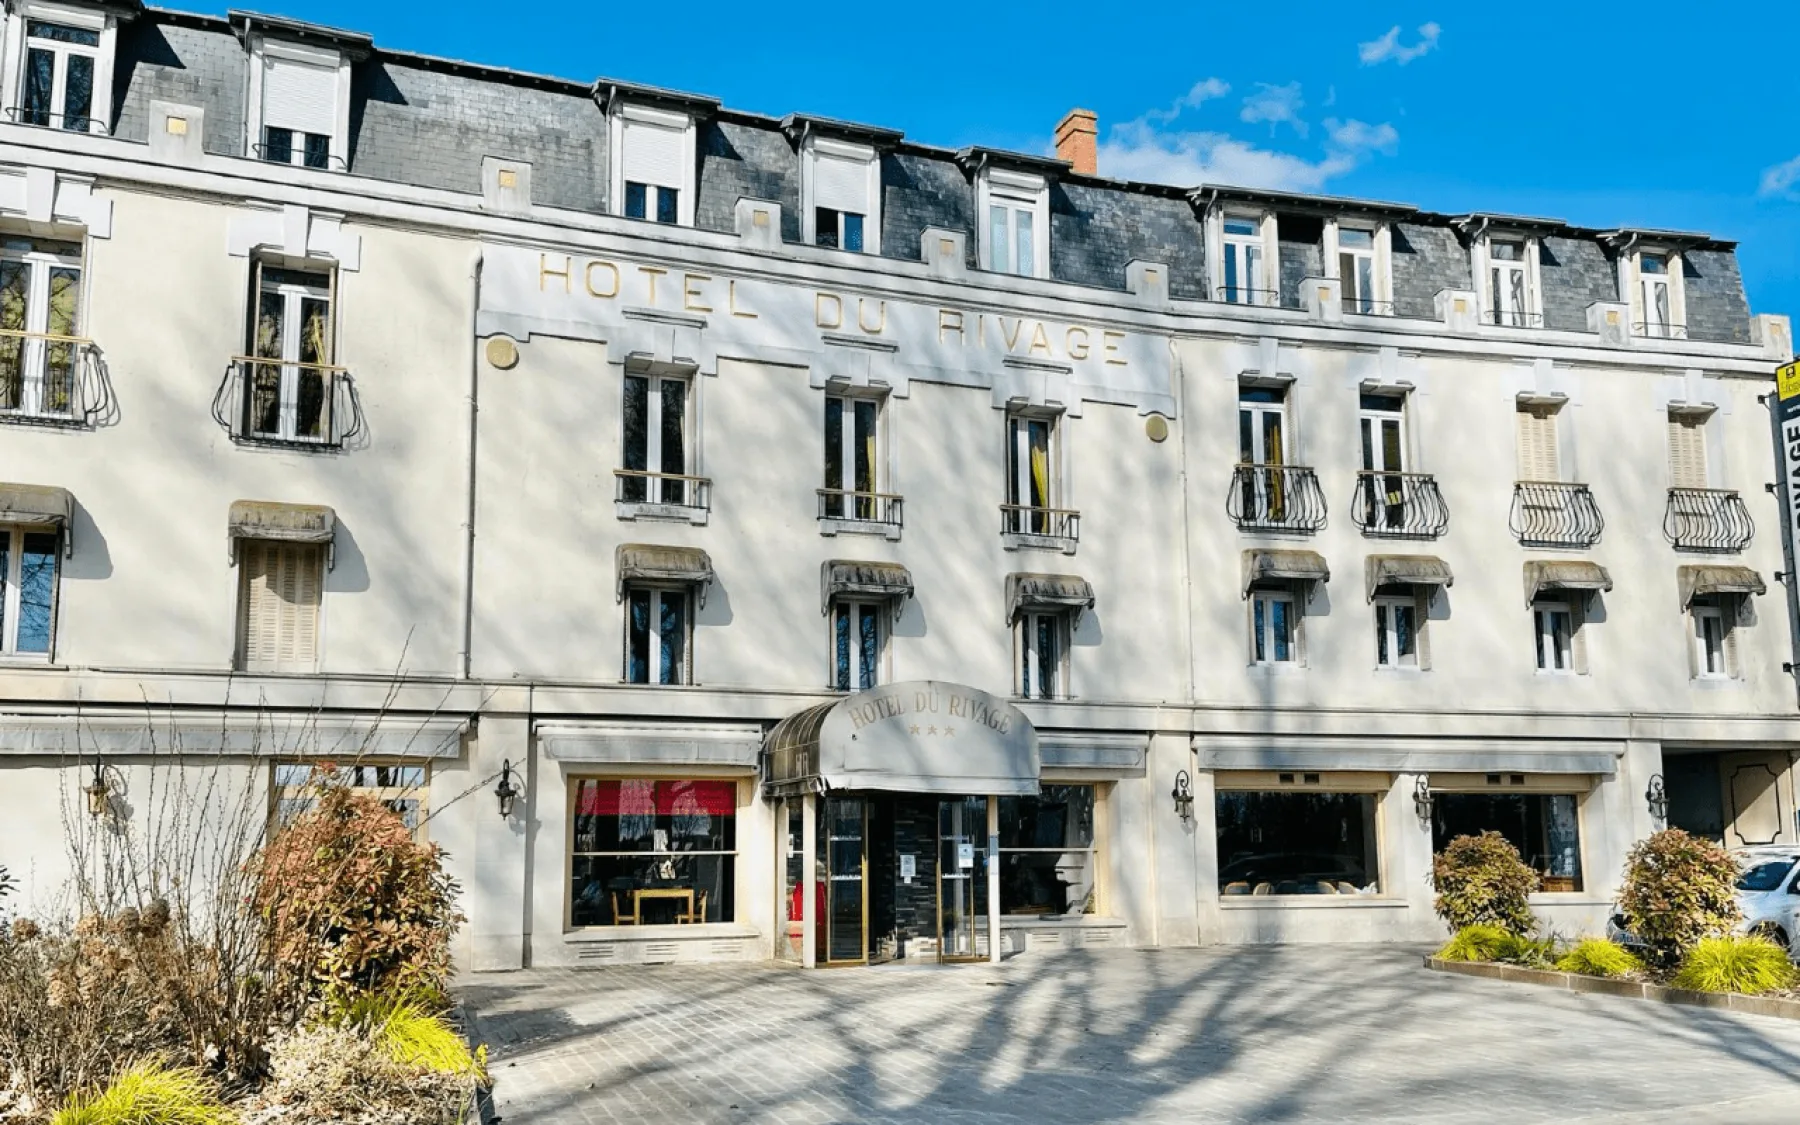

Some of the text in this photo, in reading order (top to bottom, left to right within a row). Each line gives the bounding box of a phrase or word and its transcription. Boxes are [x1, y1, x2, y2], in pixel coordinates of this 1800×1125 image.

[540, 252, 1128, 365] HOTEL DU RIVAGE
[849, 691, 1012, 735] HOTEL DU RIVAGE
